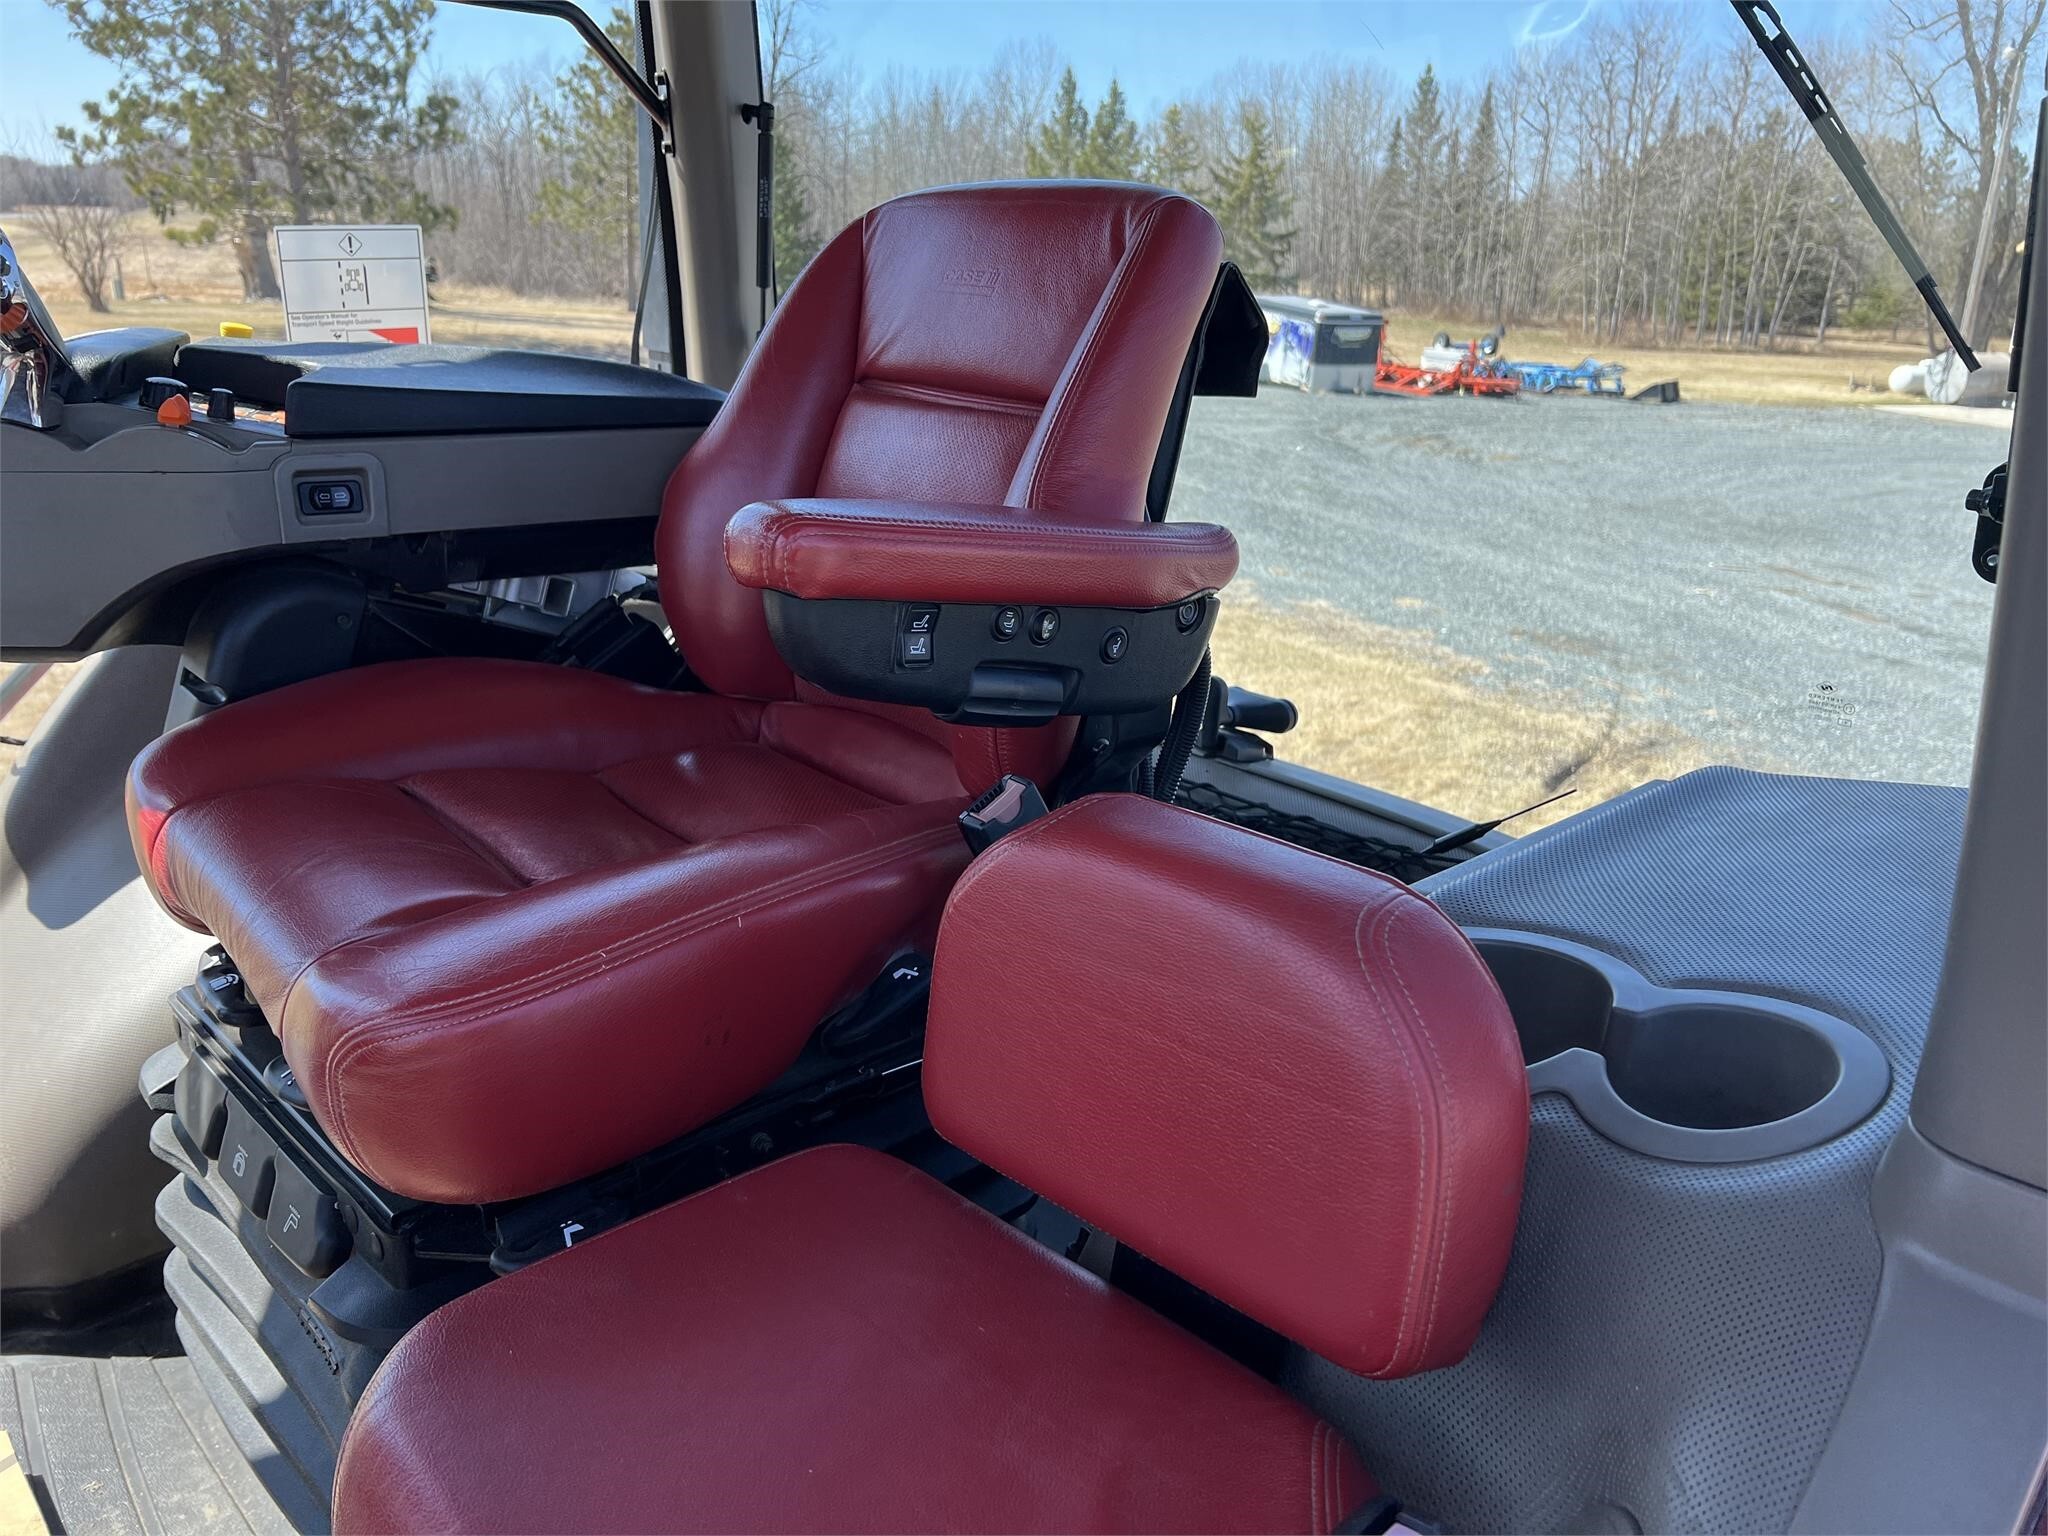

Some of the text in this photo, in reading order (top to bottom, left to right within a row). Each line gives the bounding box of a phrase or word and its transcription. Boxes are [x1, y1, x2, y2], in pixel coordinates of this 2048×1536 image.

[301, 313, 329, 321] Operator's
[291, 320, 318, 328] Transport
[319, 320, 335, 328] Speed
